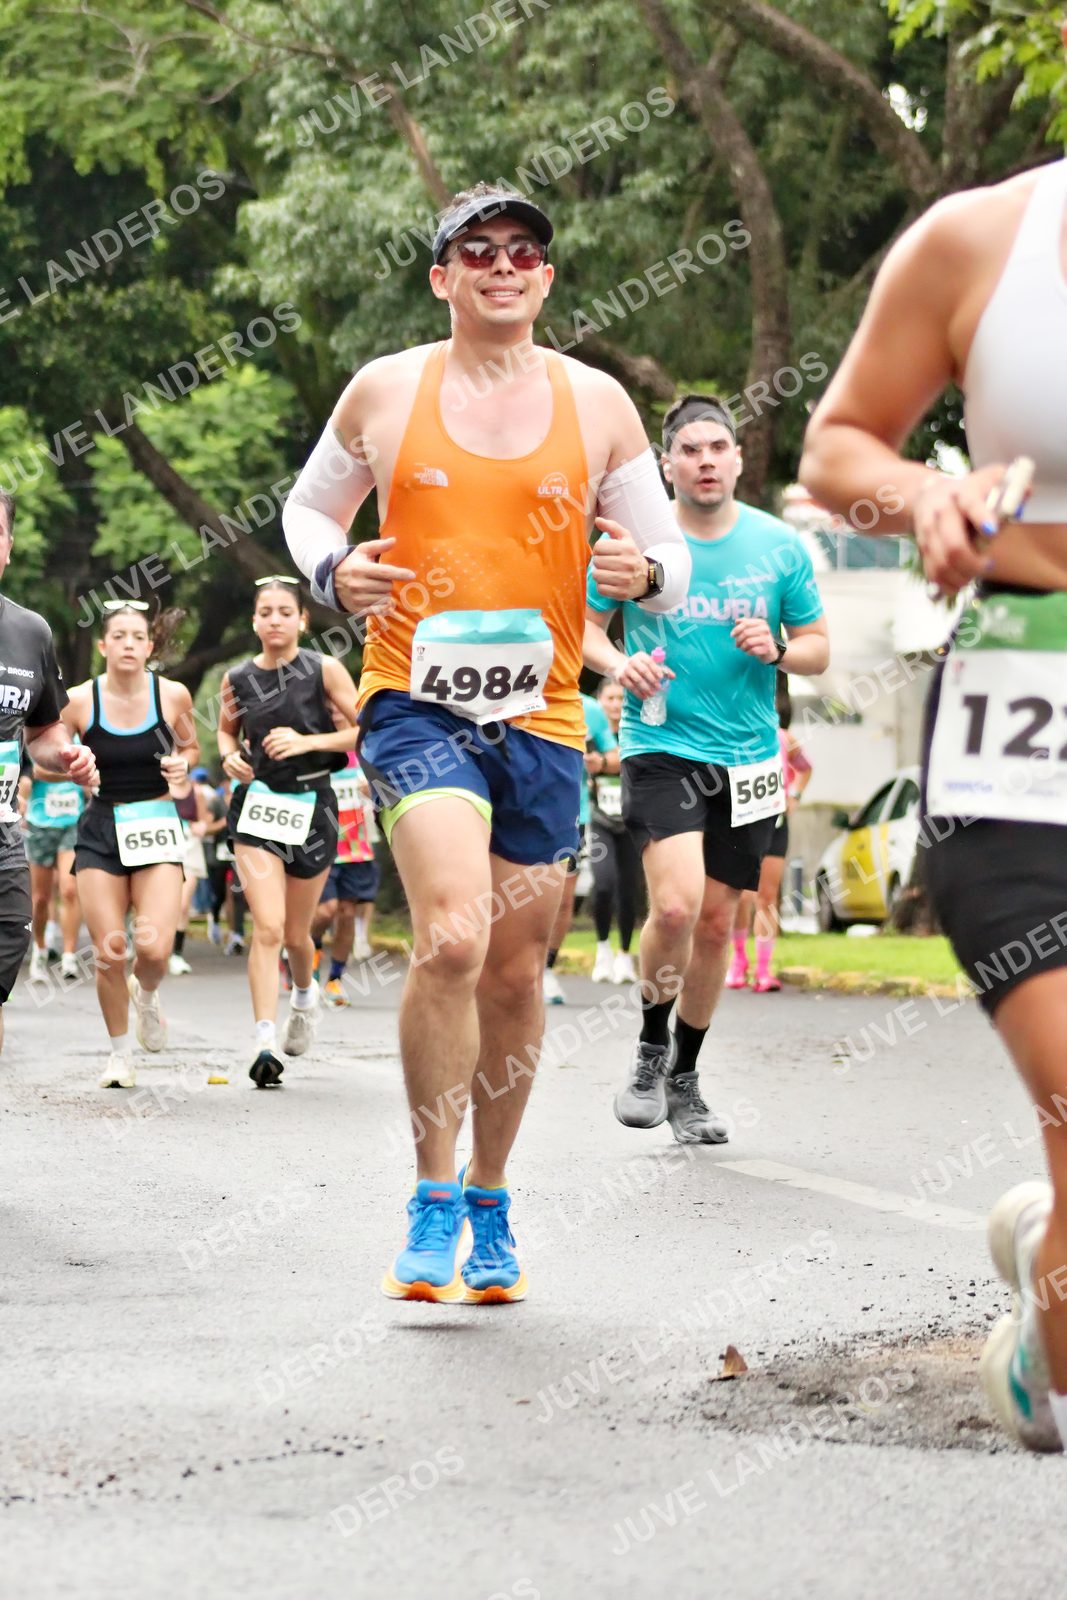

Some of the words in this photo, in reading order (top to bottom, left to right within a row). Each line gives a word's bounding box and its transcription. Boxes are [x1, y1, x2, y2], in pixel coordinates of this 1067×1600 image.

[538, 486, 569, 495] ULTRA
[8, 667, 34, 678] BROOKS
[421, 664, 539, 702] 4984
[962, 694, 1067, 762] 12
[248, 804, 305, 829] 6566
[125, 829, 177, 850] 6561
